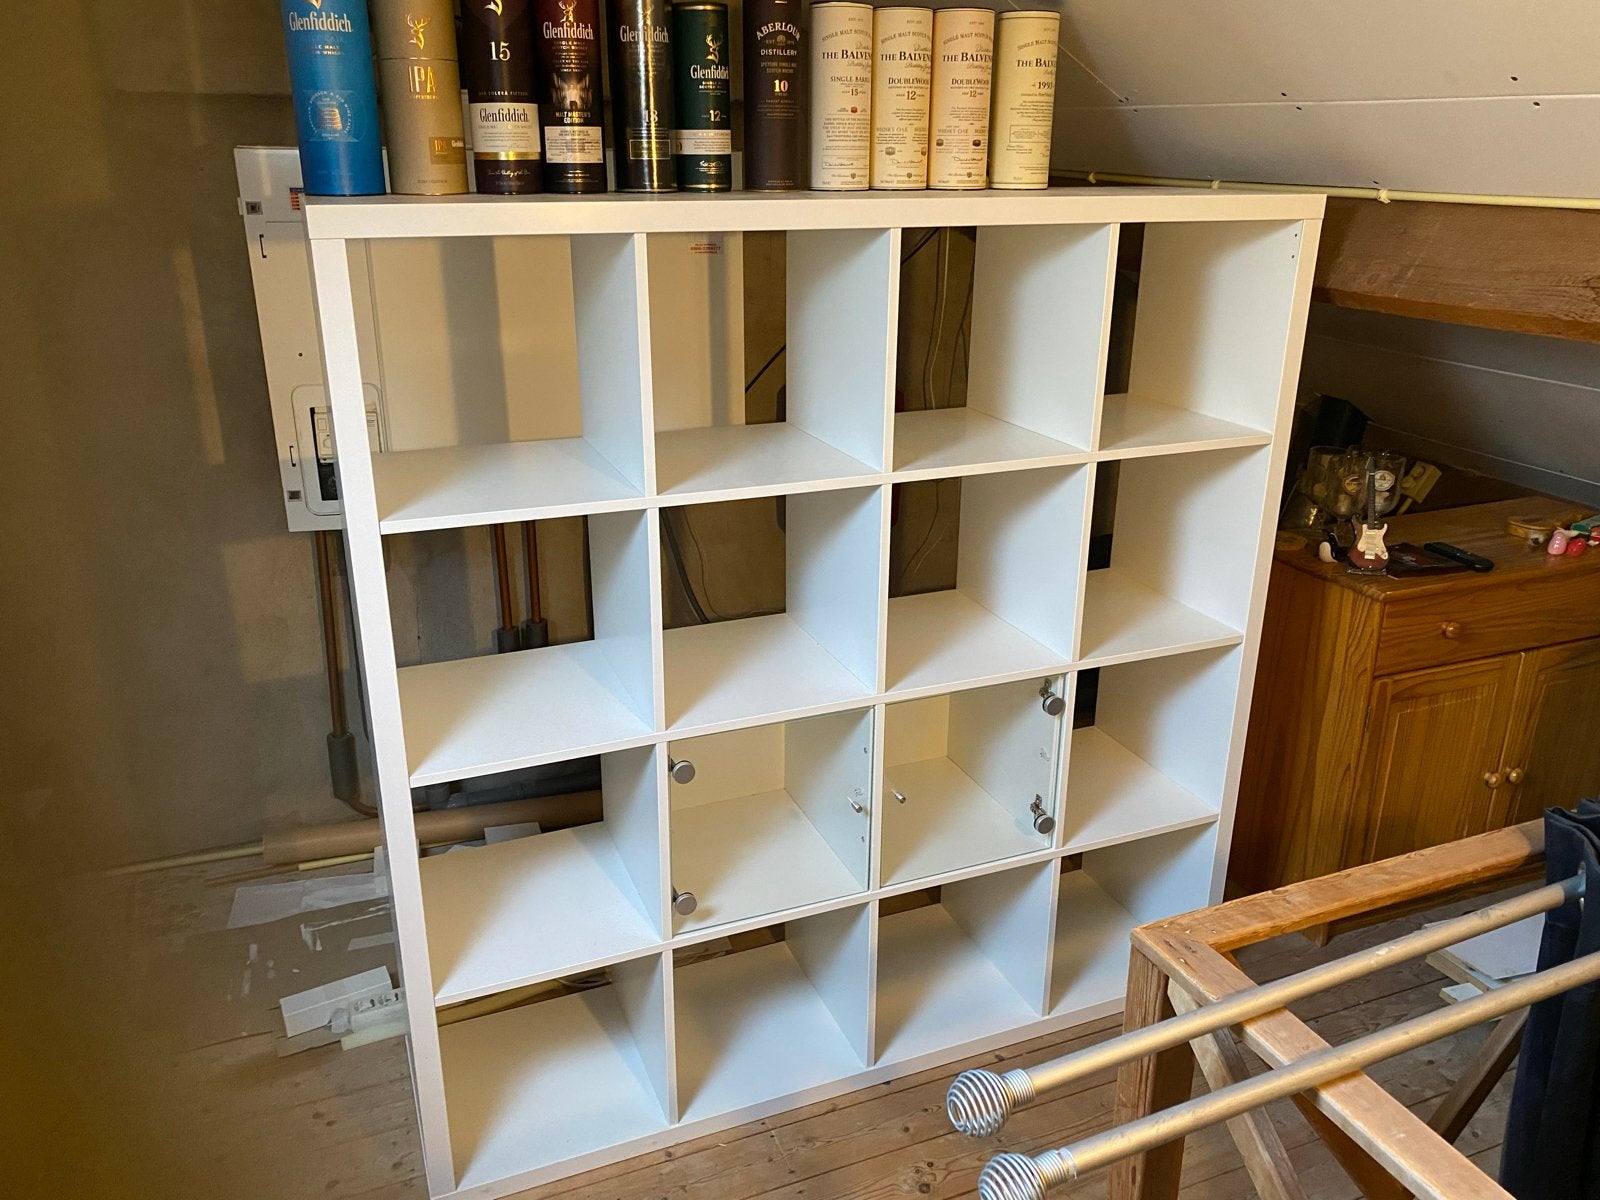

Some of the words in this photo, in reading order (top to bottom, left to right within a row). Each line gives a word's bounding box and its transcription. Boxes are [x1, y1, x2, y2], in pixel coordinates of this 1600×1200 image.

[289, 11, 352, 32] Glenfiddich
[543, 21, 594, 40] Glenfiddich
[756, 22, 800, 41] ABERLOUR
[490, 41, 510, 60] 15
[881, 53, 897, 61] THE
[943, 54, 959, 62] THE
[408, 65, 436, 93] IPA
[774, 79, 789, 92] 10
[851, 88, 859, 96] 15
[906, 90, 916, 100] 12
[969, 90, 977, 98] 12
[480, 108, 528, 122] Glenfiddich
[709, 110, 721, 121] 12
